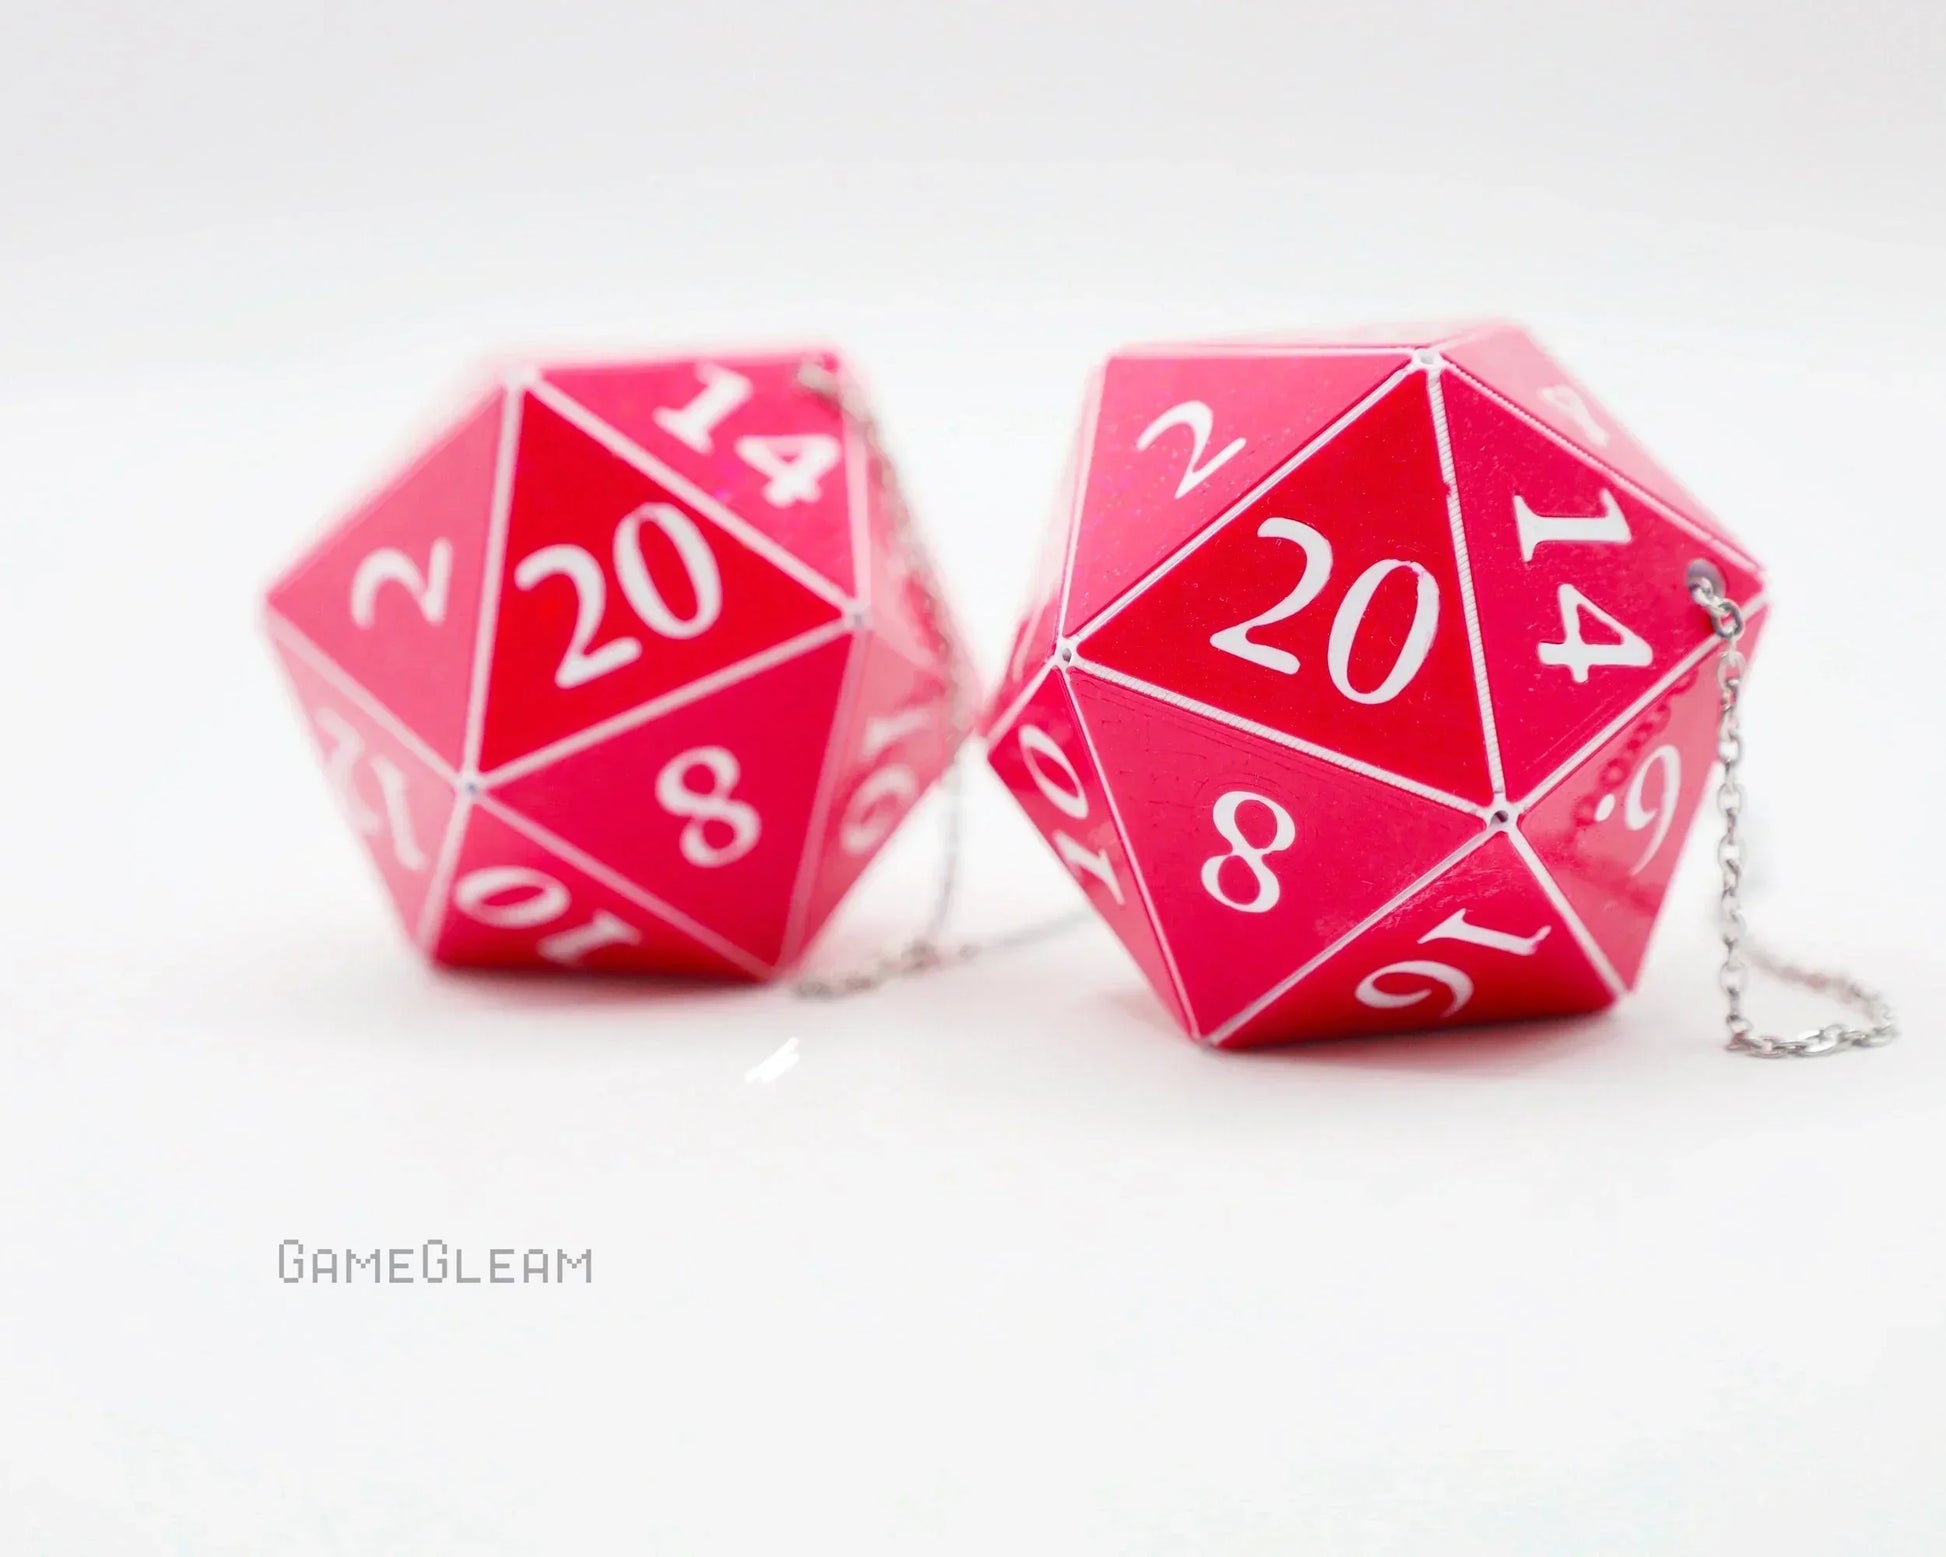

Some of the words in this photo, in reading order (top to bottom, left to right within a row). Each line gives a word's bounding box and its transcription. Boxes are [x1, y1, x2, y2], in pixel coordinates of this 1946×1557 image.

[652, 362, 842, 508] 14
[1136, 400, 1247, 499] 2
[350, 538, 453, 630] 2
[514, 502, 722, 689] 20
[1209, 517, 1440, 705] 20
[1513, 488, 1653, 684] 14
[655, 746, 761, 867] 8
[1018, 724, 1125, 906] 10
[1200, 791, 1296, 914] 8
[455, 865, 642, 968] 10
[1355, 908, 1552, 1018] 16
